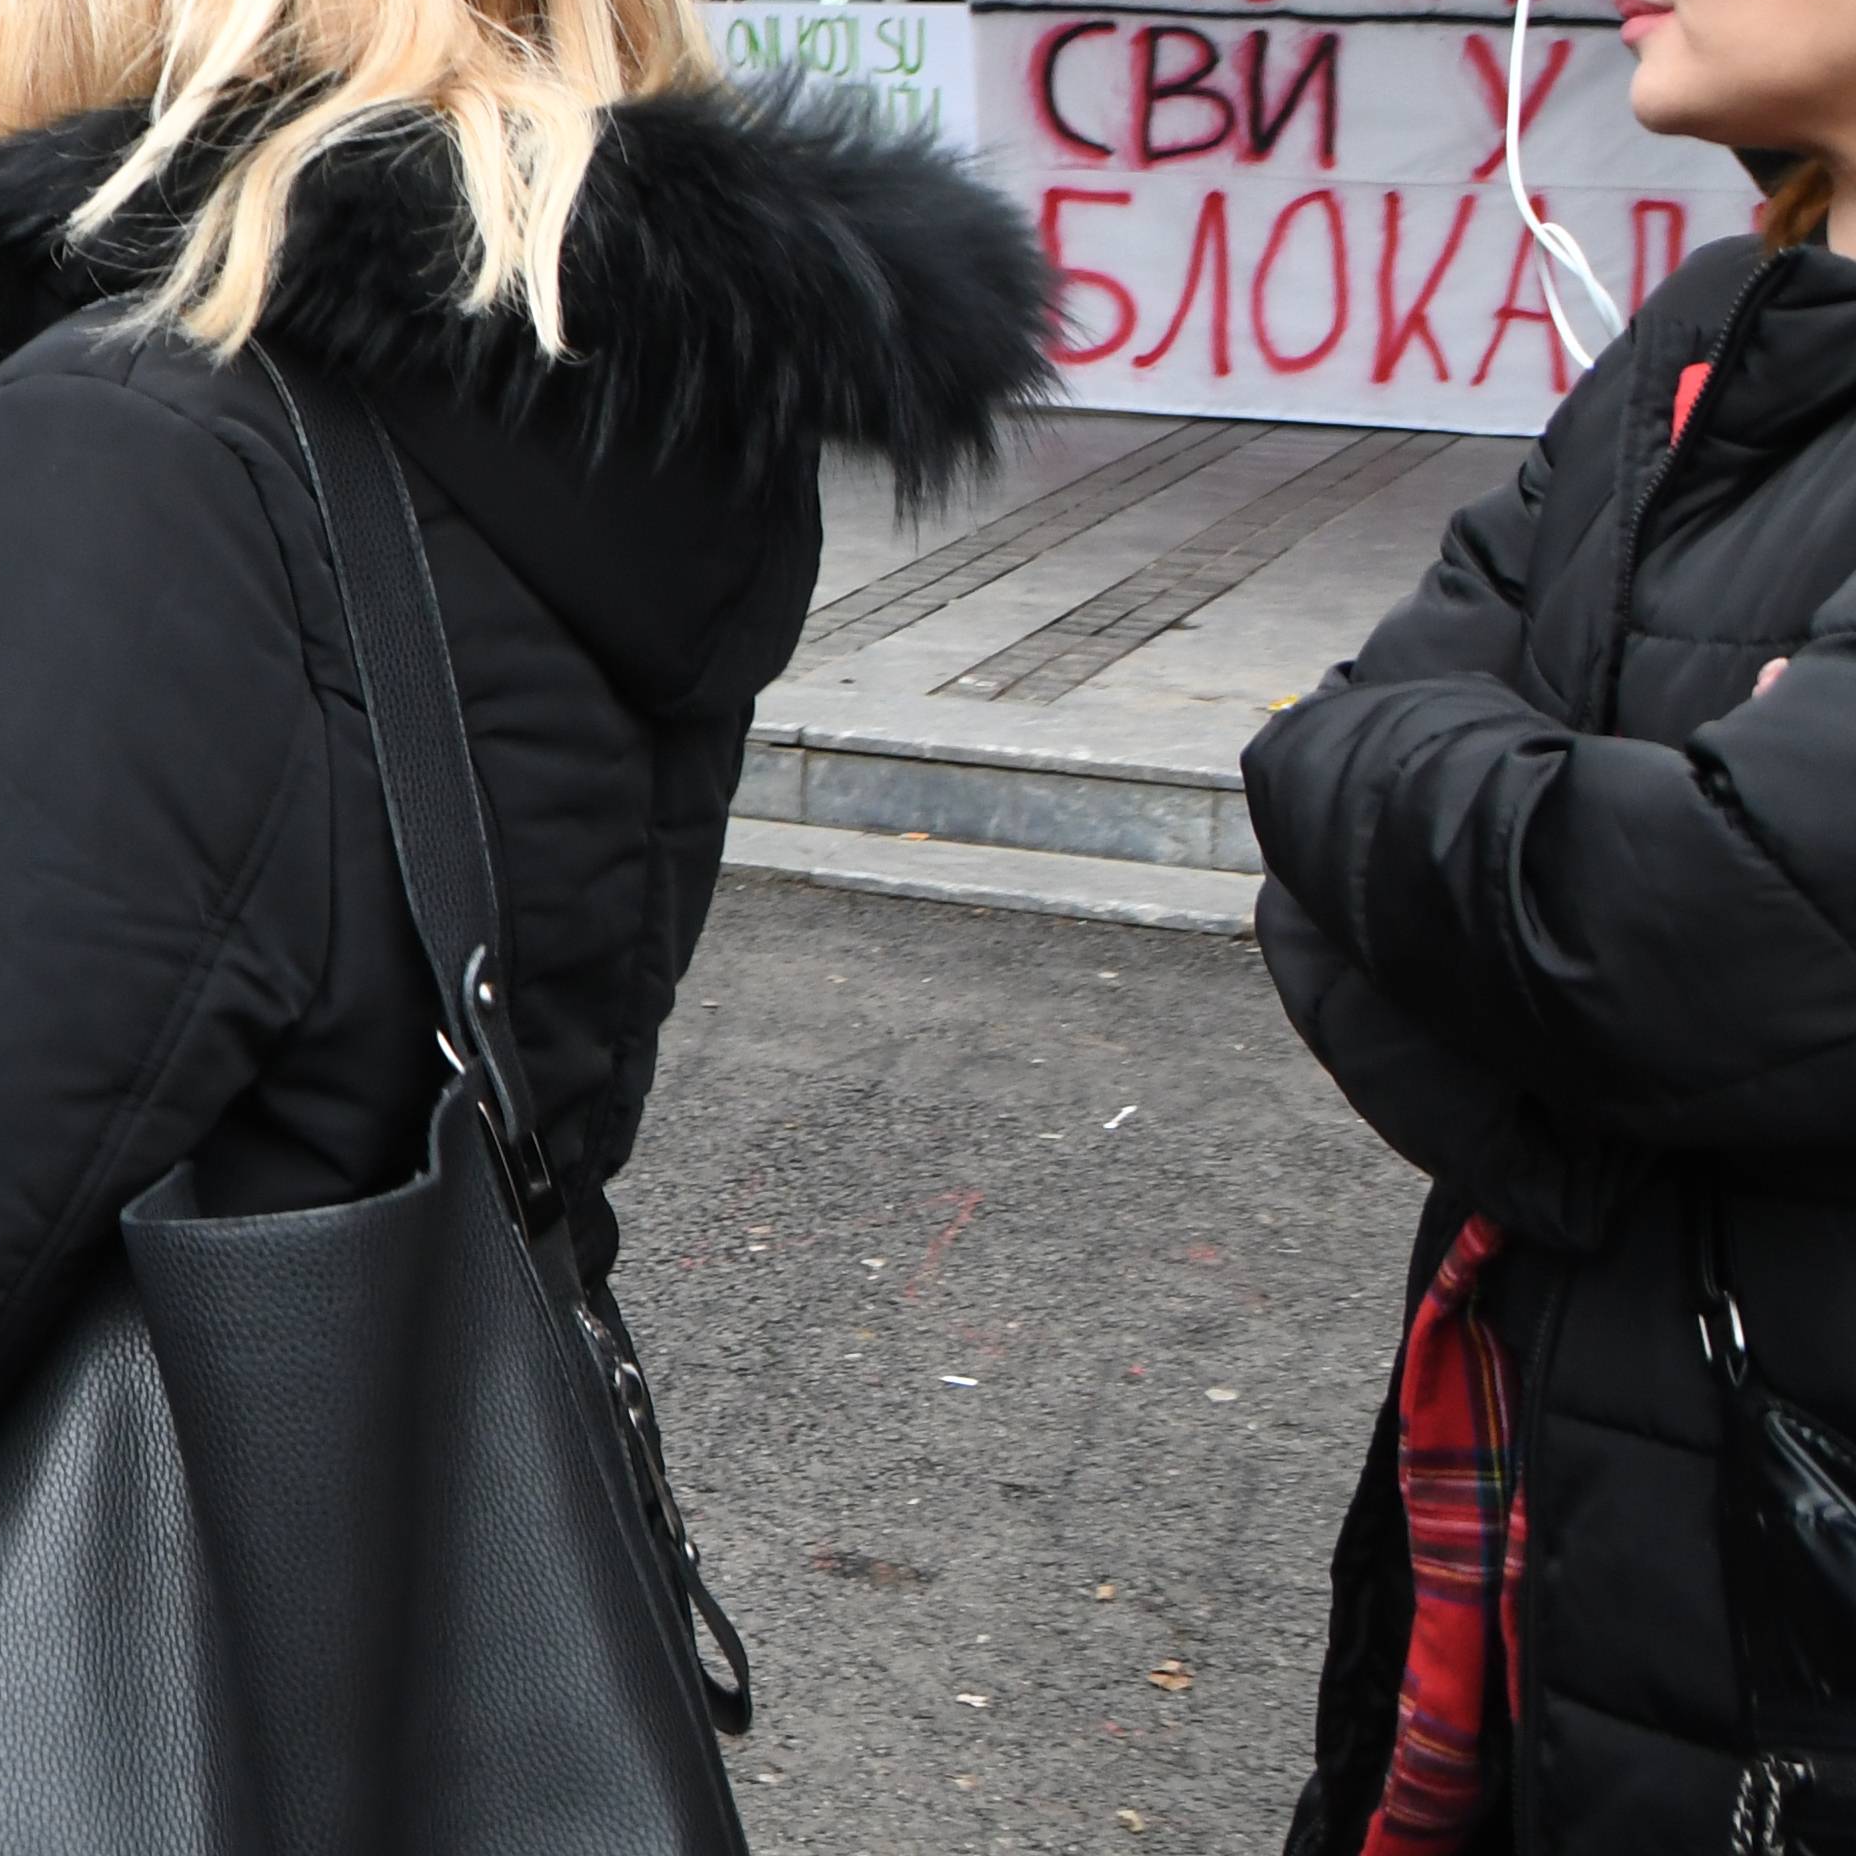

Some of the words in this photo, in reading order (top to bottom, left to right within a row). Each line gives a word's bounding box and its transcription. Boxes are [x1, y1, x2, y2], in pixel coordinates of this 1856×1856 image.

[874, 15, 926, 76] SU
[1030, 20, 1339, 171] СВИ
[1460, 33, 1573, 183] У
[1040, 186, 1770, 394] БЛОКА
